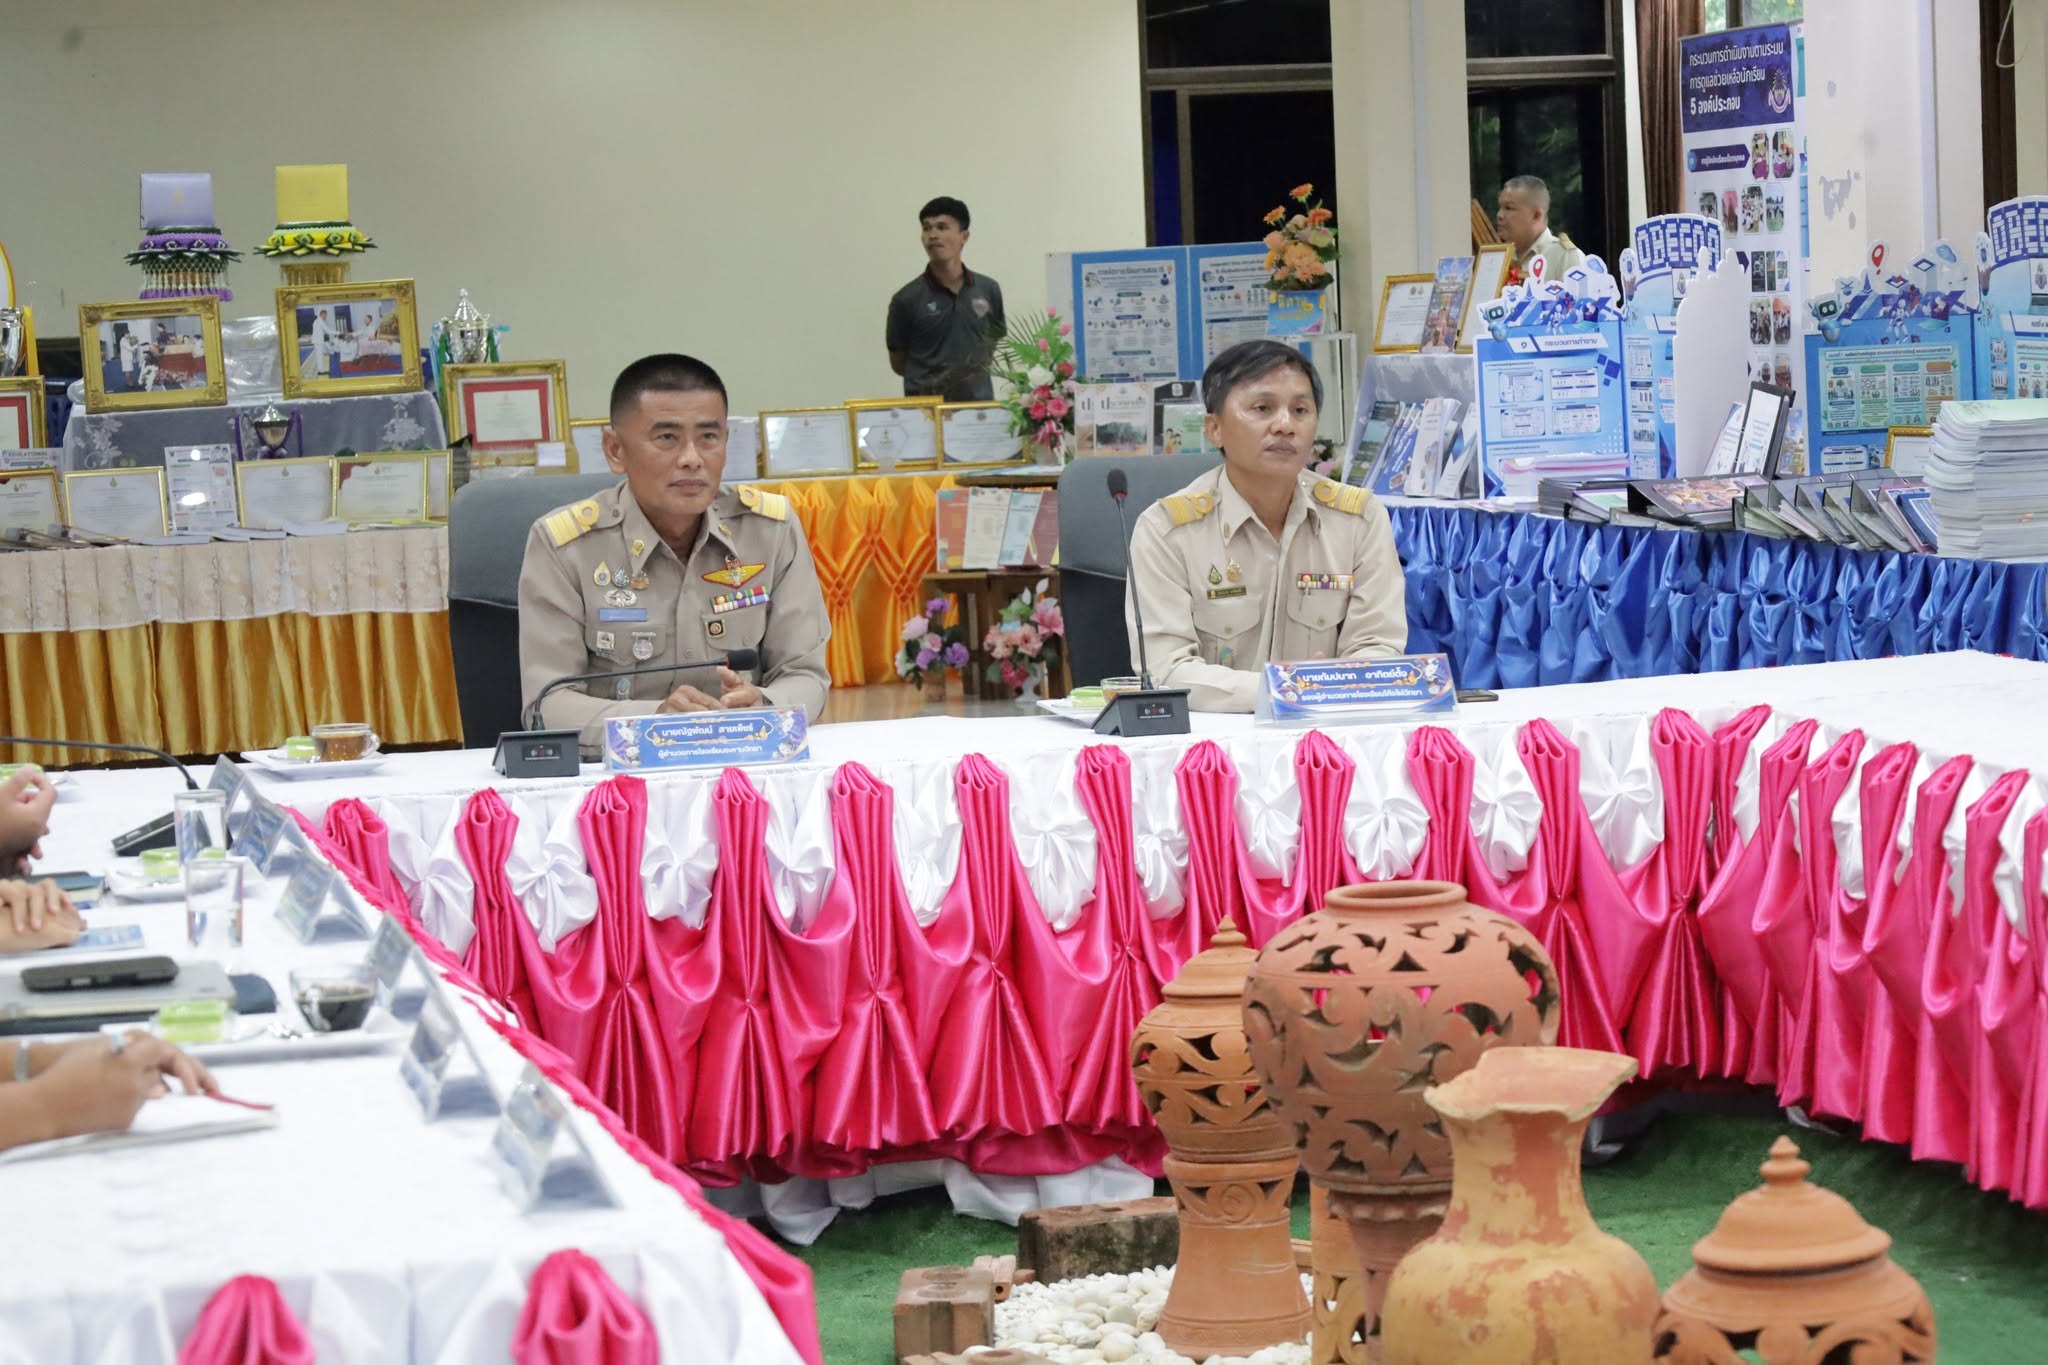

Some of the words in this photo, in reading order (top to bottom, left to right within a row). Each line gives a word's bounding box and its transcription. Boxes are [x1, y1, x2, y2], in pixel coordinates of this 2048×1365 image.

[1689, 41, 1784, 67] กระบวนการดำเนินงานตามระบบ
[1689, 66, 1766, 93] การดูแลช่วยเหลือนักเรียน
[1690, 97, 1697, 115] 5
[1698, 95, 1741, 114] องค์ประกอบ
